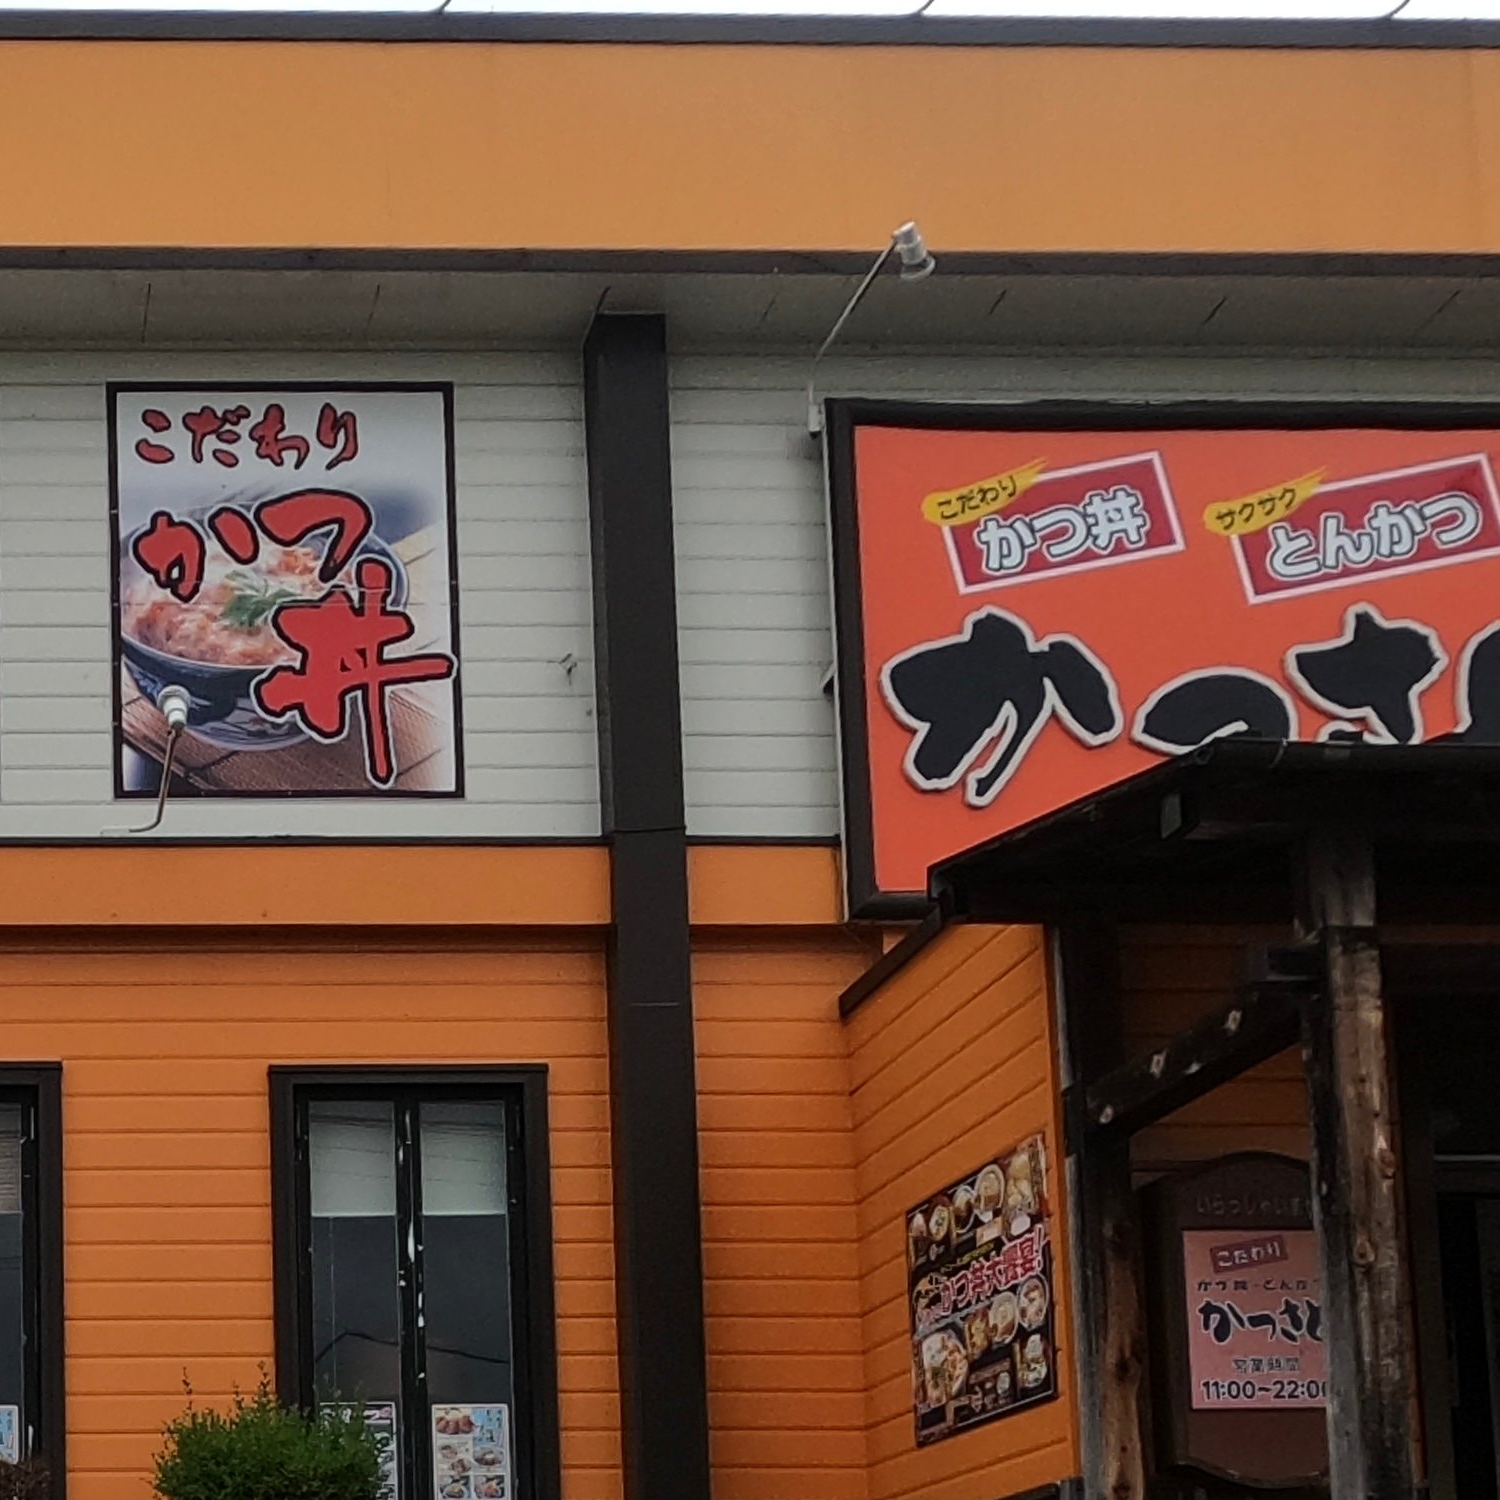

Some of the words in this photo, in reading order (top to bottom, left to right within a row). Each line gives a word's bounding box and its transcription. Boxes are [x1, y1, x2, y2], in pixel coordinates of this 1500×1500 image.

[136, 403, 359, 470] こだわり
[936, 474, 1019, 519] こだわり
[1215, 486, 1298, 530] サクサク
[979, 484, 1147, 574] かつ丼
[1269, 492, 1483, 579] とんかつ
[1217, 1241, 1281, 1267] こだわり
